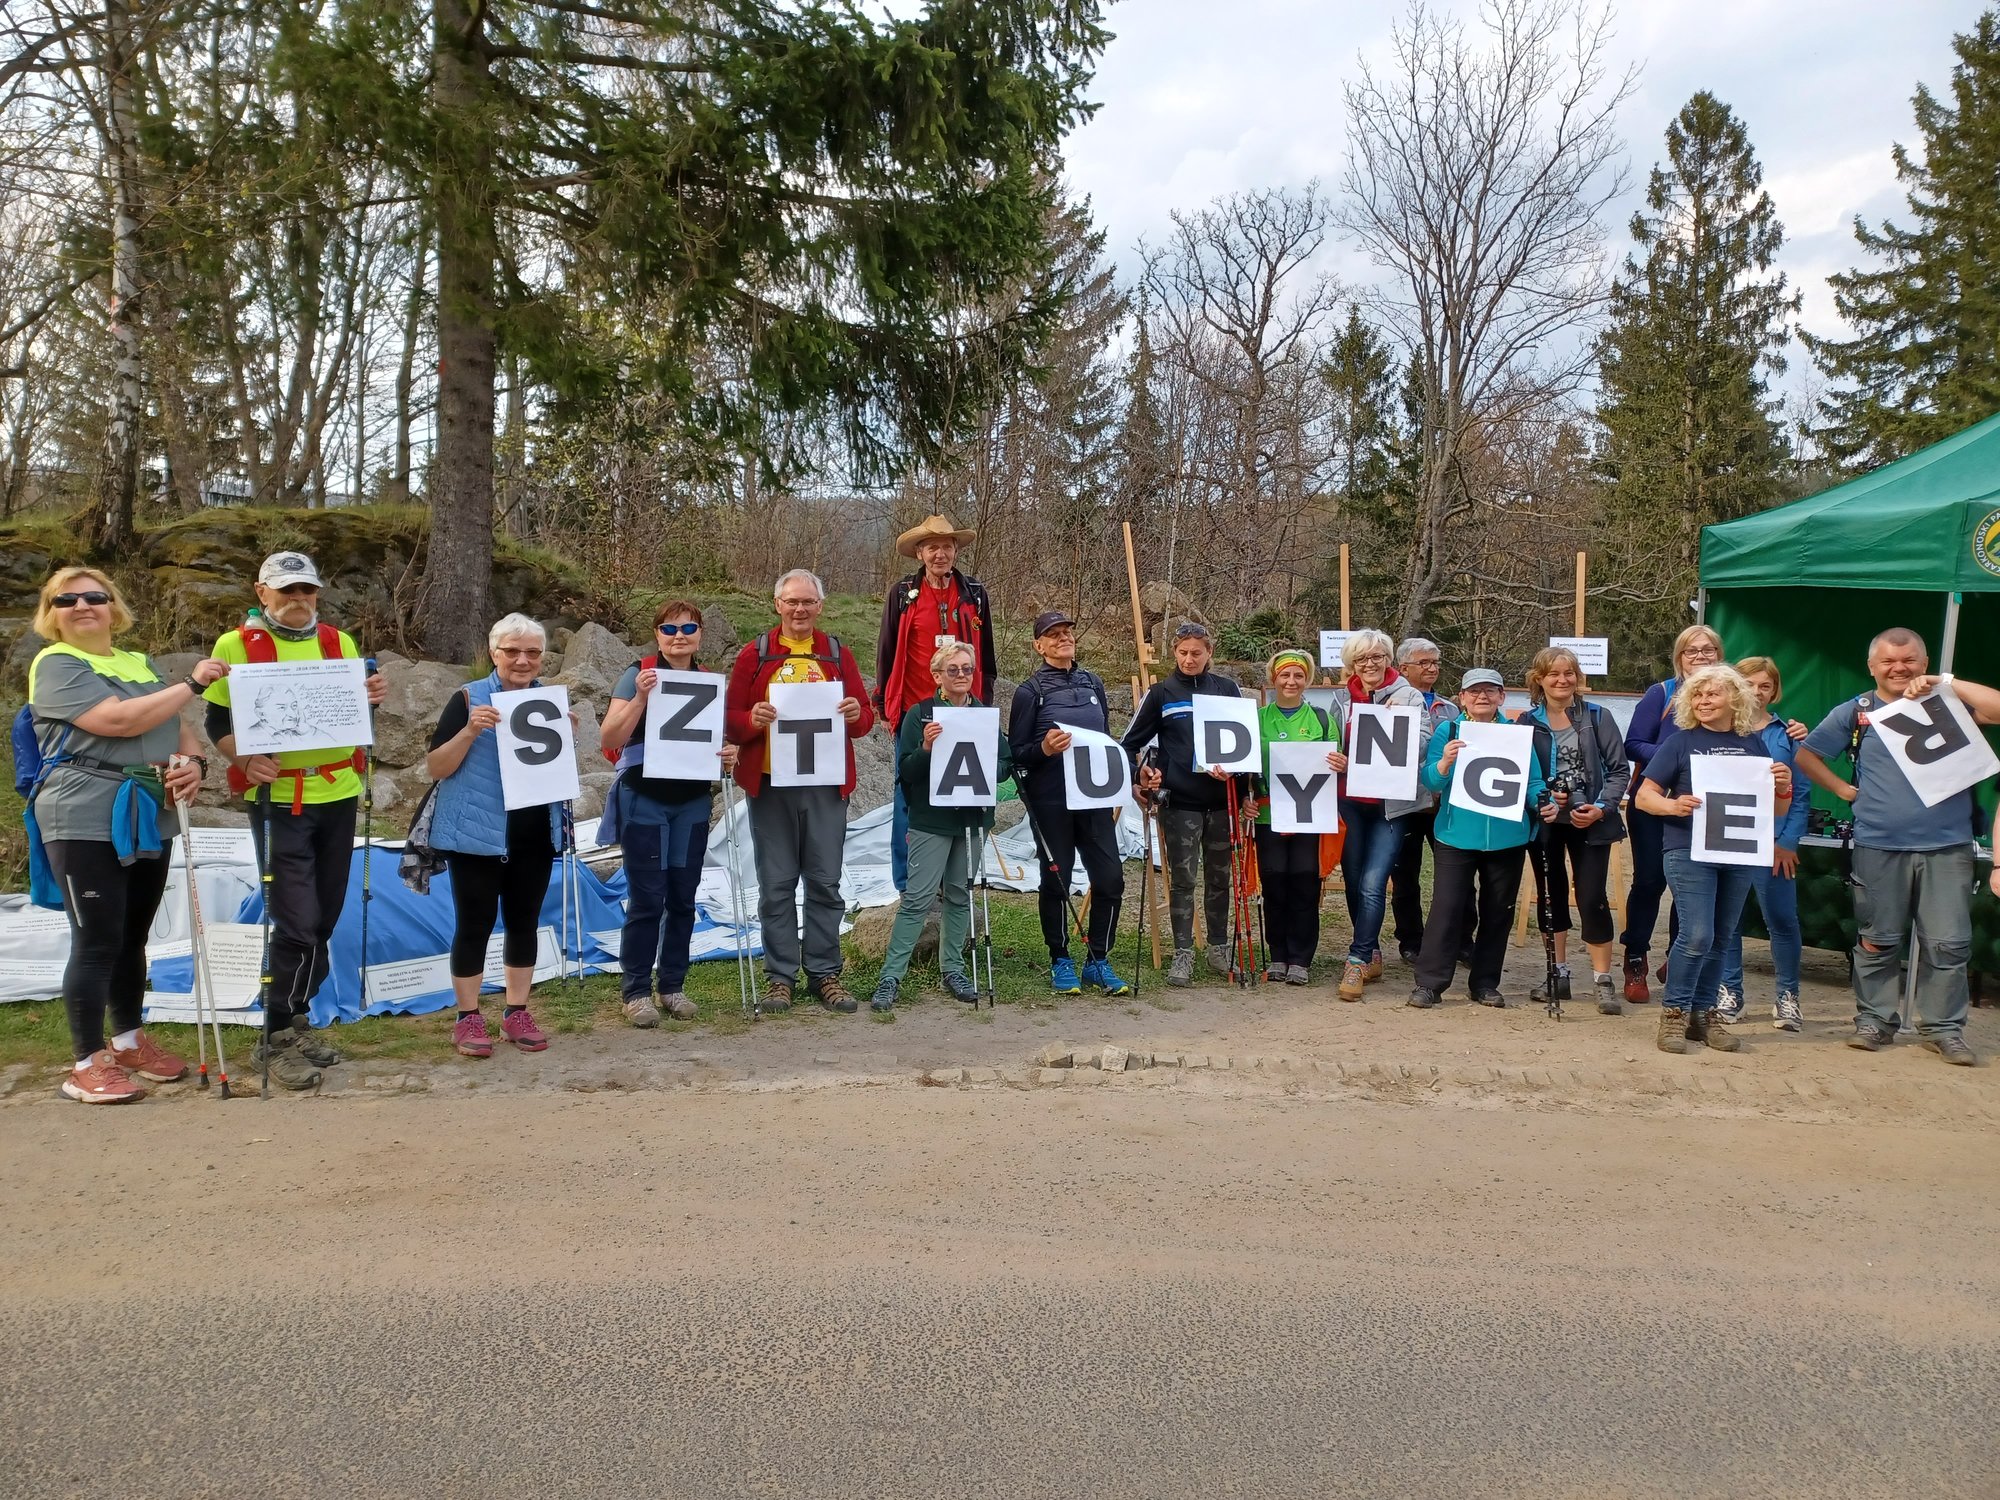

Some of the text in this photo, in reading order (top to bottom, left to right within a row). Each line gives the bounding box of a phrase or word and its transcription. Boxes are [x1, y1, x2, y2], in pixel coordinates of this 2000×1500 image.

[511, 700, 562, 765] S
[660, 681, 717, 742] Z
[1879, 695, 1971, 765] R
[778, 718, 832, 774] T
[1203, 721, 1252, 764] D
[1356, 714, 1409, 766] N
[936, 742, 990, 796] A
[1073, 746, 1124, 798] U
[1463, 757, 1520, 807] G
[1276, 774, 1331, 823] Y
[1705, 792, 1757, 854] E
